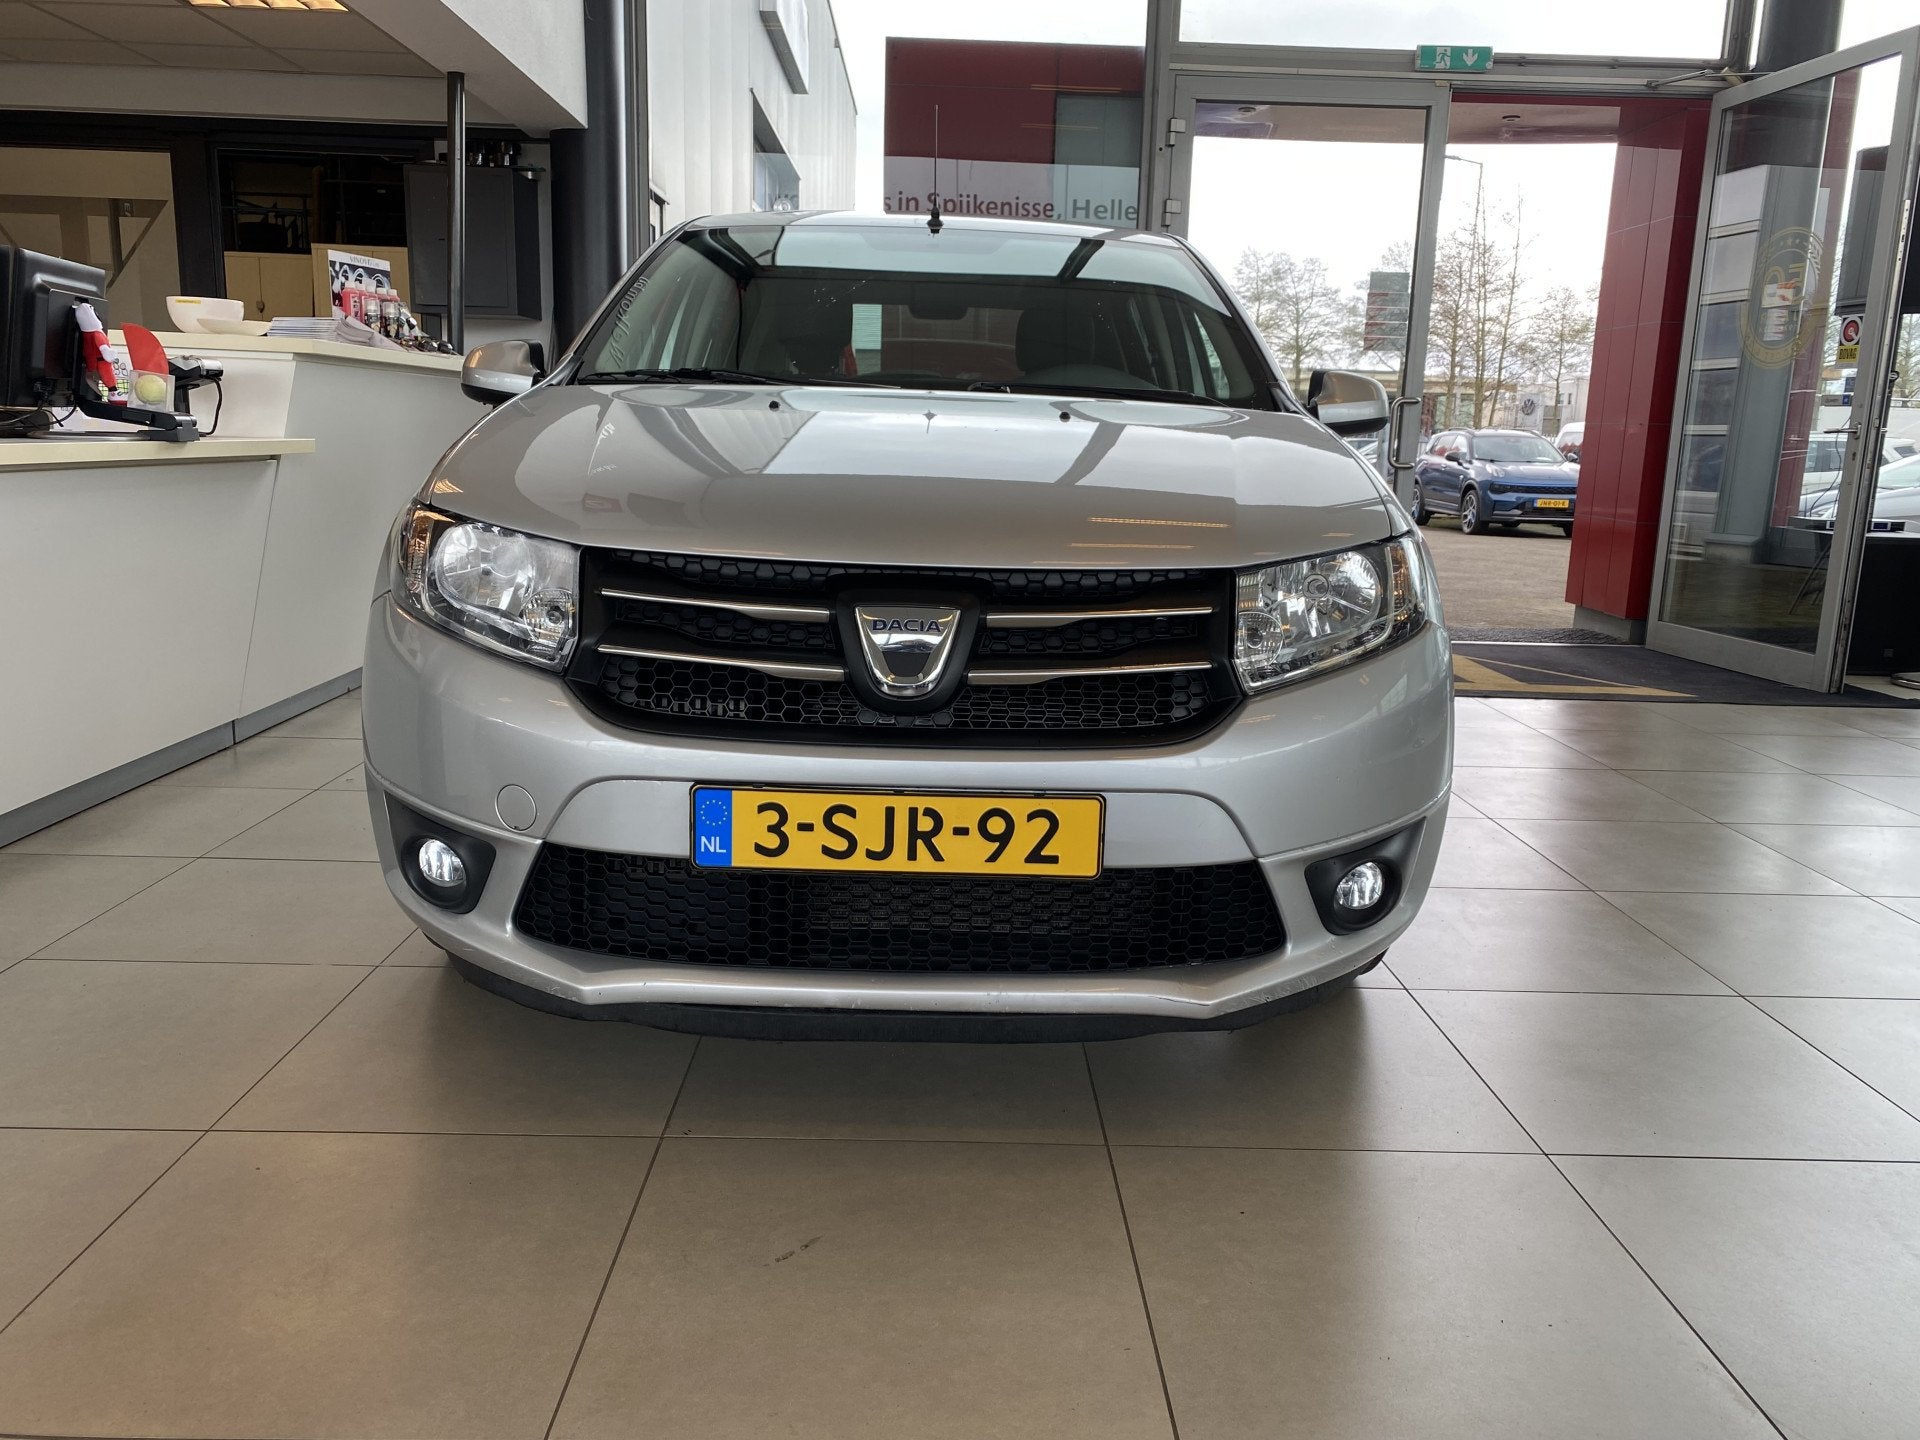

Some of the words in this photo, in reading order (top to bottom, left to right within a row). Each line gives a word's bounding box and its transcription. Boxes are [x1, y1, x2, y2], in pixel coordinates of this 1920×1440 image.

[898, 191, 919, 212] in
[1072, 198, 1137, 220] Helle
[1839, 347, 1857, 360] BOVAG
[872, 619, 941, 632] DACIA
[700, 836, 727, 853] NL
[753, 801, 1060, 865] 3-SJR-92
